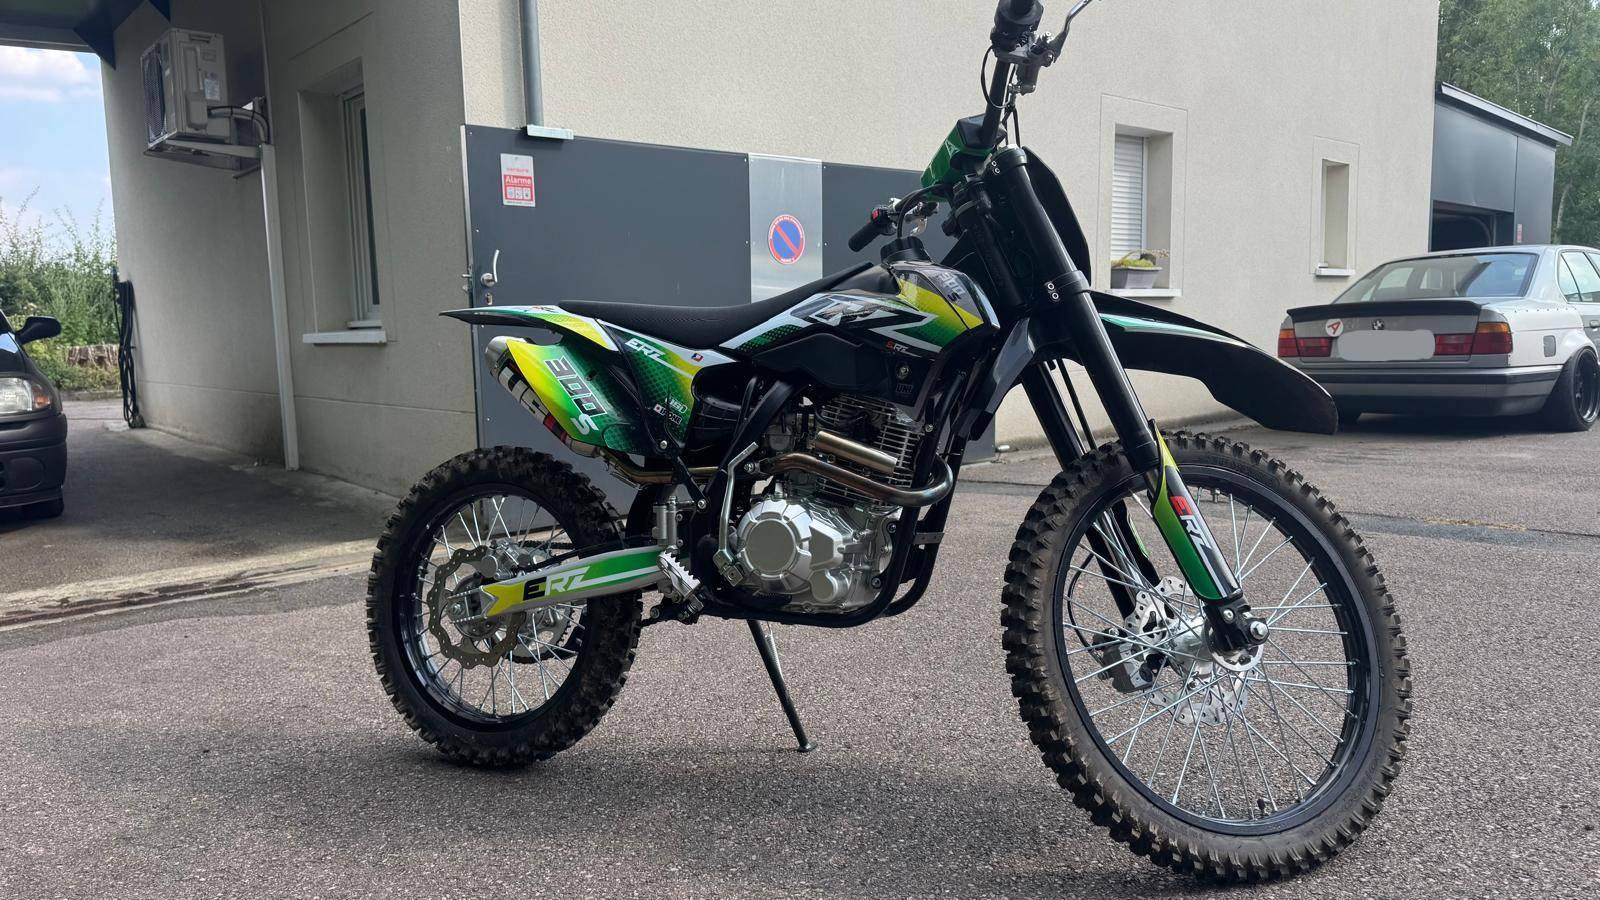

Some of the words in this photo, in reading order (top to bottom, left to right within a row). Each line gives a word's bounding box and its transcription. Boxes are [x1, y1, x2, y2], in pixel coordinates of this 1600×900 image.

[506, 175, 531, 185] Alarme
[1327, 321, 1341, 335] A
[625, 338, 666, 362] ERZ
[544, 356, 607, 418] 300
[523, 566, 592, 601] ERZ
